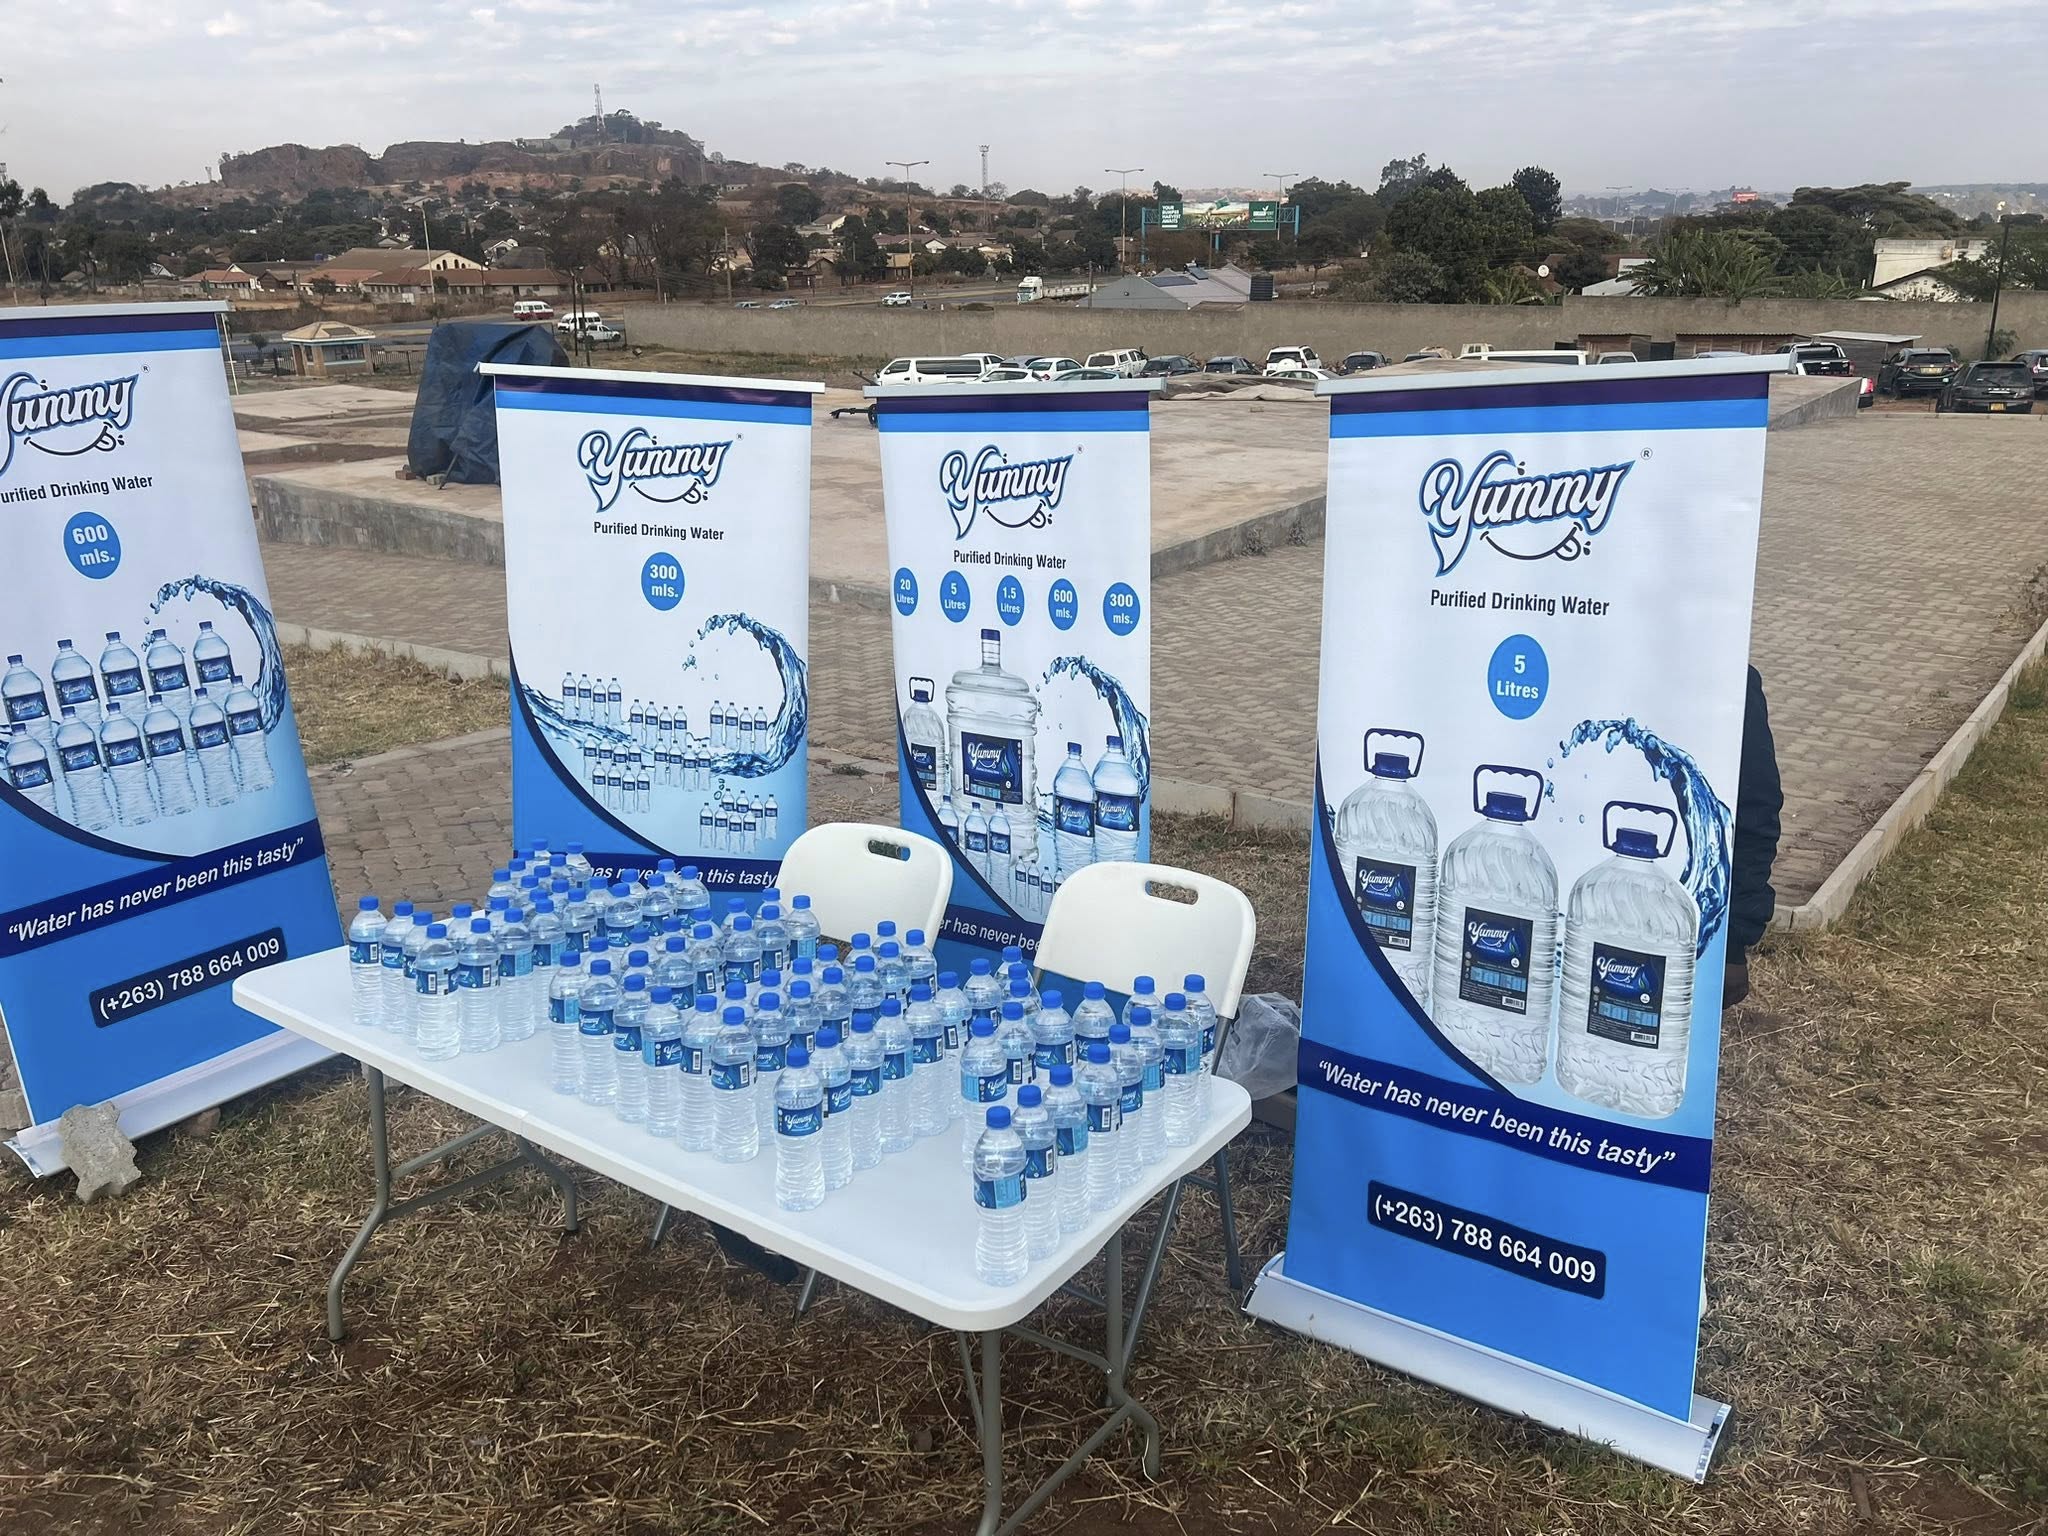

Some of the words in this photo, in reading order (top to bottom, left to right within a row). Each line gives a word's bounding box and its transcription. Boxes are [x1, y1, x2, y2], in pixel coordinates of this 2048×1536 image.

[577, 426, 733, 513] Yummy
[0, 486, 46, 504] urified
[51, 480, 109, 495] Drinking
[112, 476, 153, 491] Water
[940, 444, 1074, 541] Yummy
[1419, 449, 1636, 577] Yummy
[72, 524, 108, 544] 600
[593, 521, 637, 536] Purified
[641, 524, 687, 540] Drinking
[690, 526, 724, 541] Water
[80, 548, 115, 566] mls.
[953, 550, 991, 565] Purified
[994, 552, 1033, 570] Drinking
[1036, 555, 1067, 570] Water
[650, 565, 677, 580] 300
[651, 584, 678, 598] mls.
[900, 579, 911, 590] 20
[951, 583, 957, 595] 5
[1003, 587, 1016, 599] 1.5
[896, 594, 914, 605] Litres
[944, 599, 966, 610] Litres
[1053, 590, 1073, 604] 600
[1110, 594, 1133, 607] 300
[1430, 588, 1486, 610] Purified
[1491, 591, 1556, 616] Drinking
[1561, 596, 1610, 616] Water
[1001, 603, 1020, 614] Litres
[1055, 608, 1073, 619] mls.
[1113, 613, 1133, 625] mls.
[1514, 655, 1525, 673] 5
[1496, 680, 1539, 699] Litres
[967, 742, 1002, 768] Yummy
[81, 899, 114, 922] has
[119, 881, 171, 911] never
[176, 865, 218, 892] been
[223, 854, 252, 877] this
[257, 837, 303, 867] tasty”
[707, 868, 733, 884] this
[1359, 869, 1395, 891] Yummy
[953, 917, 977, 936] has
[979, 927, 1016, 946] never
[1468, 921, 1509, 944] Yummy
[99, 979, 164, 1019] (+263)
[168, 964, 204, 991] 788
[208, 951, 243, 977] 664
[247, 937, 279, 963] 009
[1596, 956, 1639, 980] Yummy
[1383, 1079, 1421, 1107] has
[1425, 1097, 1488, 1125] never
[1491, 1108, 1544, 1142] been
[1549, 1126, 1592, 1156] this
[1597, 1138, 1676, 1174] tasty”
[1374, 1194, 1444, 1240] (+263)
[1451, 1218, 1492, 1251] 788
[1498, 1235, 1542, 1269] 664
[1549, 1252, 1596, 1284] 009
